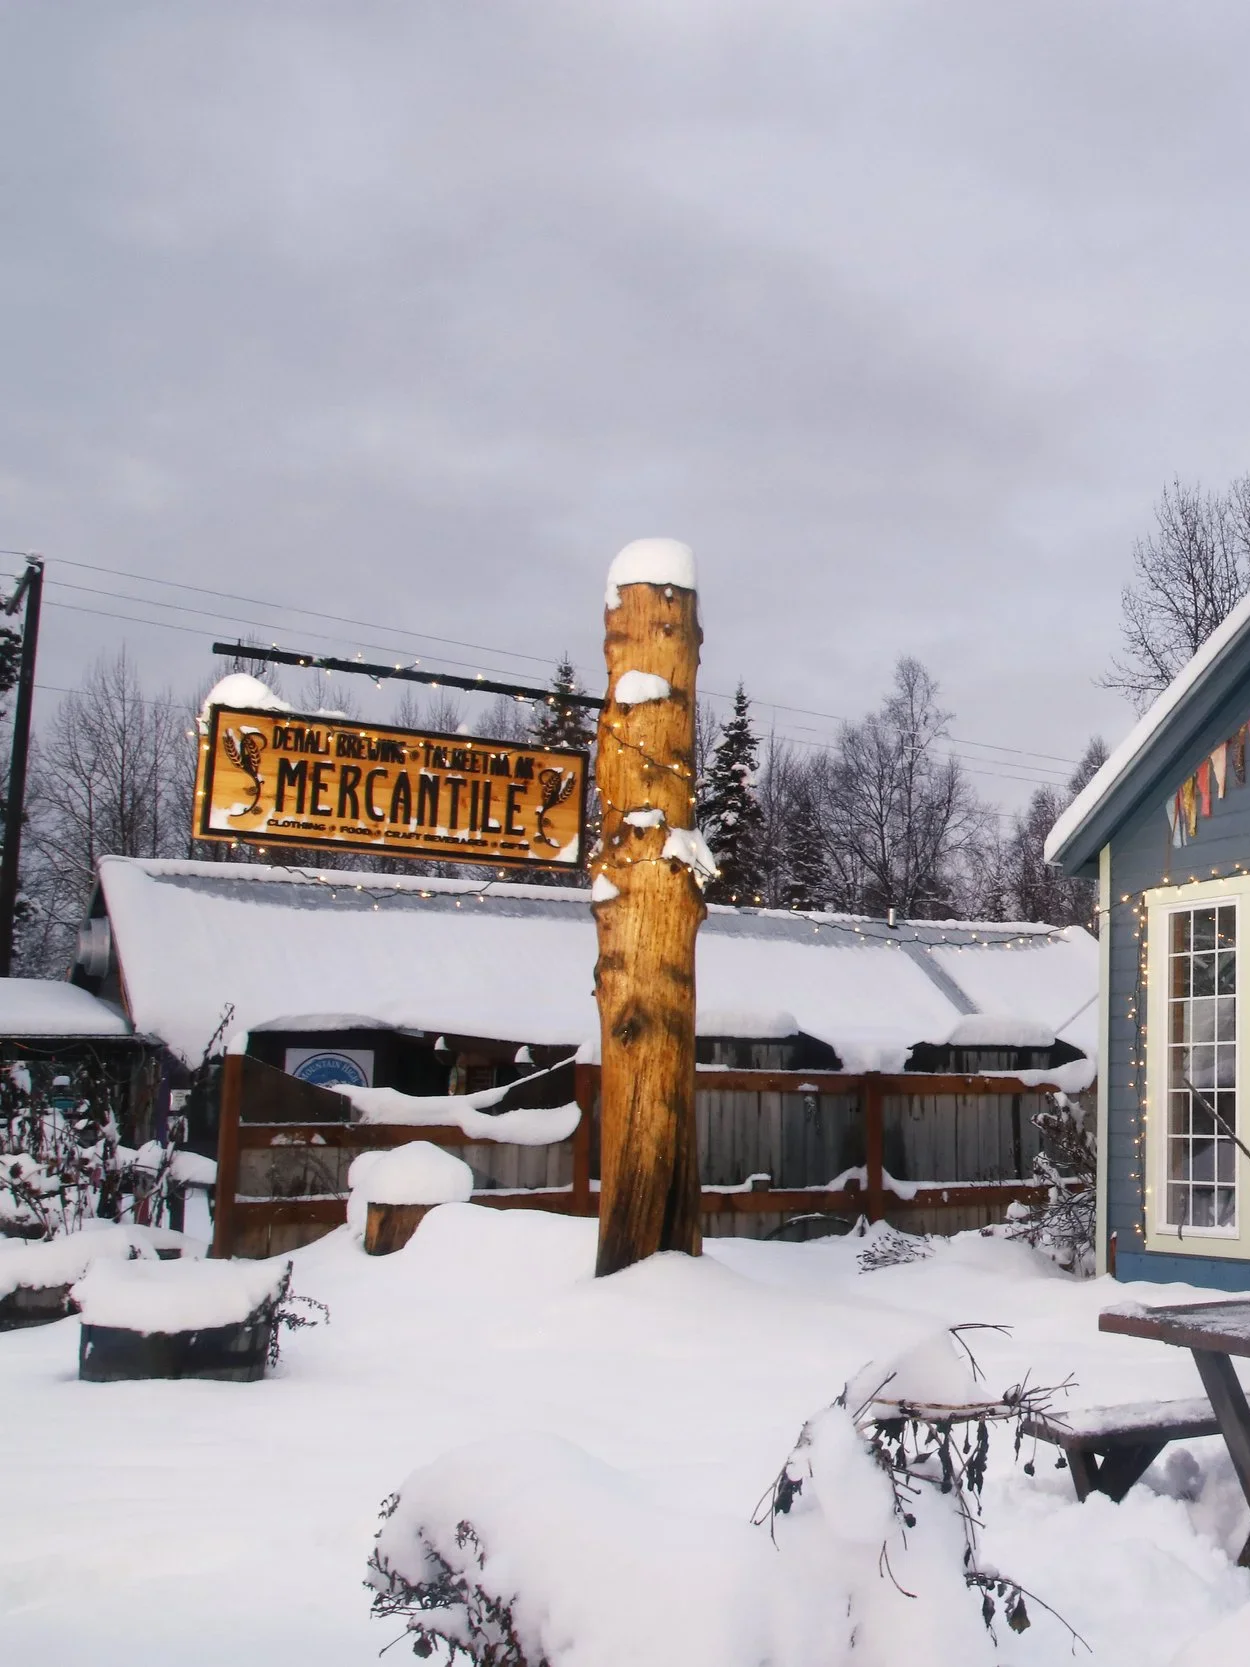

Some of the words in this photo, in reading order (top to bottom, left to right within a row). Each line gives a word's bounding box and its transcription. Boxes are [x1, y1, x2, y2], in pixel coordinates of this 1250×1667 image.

[272, 725, 331, 755] DENALI
[336, 732, 407, 764] BREWING
[275, 757, 528, 836] MERCANTILE
[266, 819, 327, 832] CLOTHING
[339, 825, 373, 836] FOOD
[384, 830, 422, 841] CRAFT
[423, 833, 489, 847] BEVERAGES
[500, 841, 531, 850] GIFTS
[302, 1060, 341, 1080] MOUNTAIN
